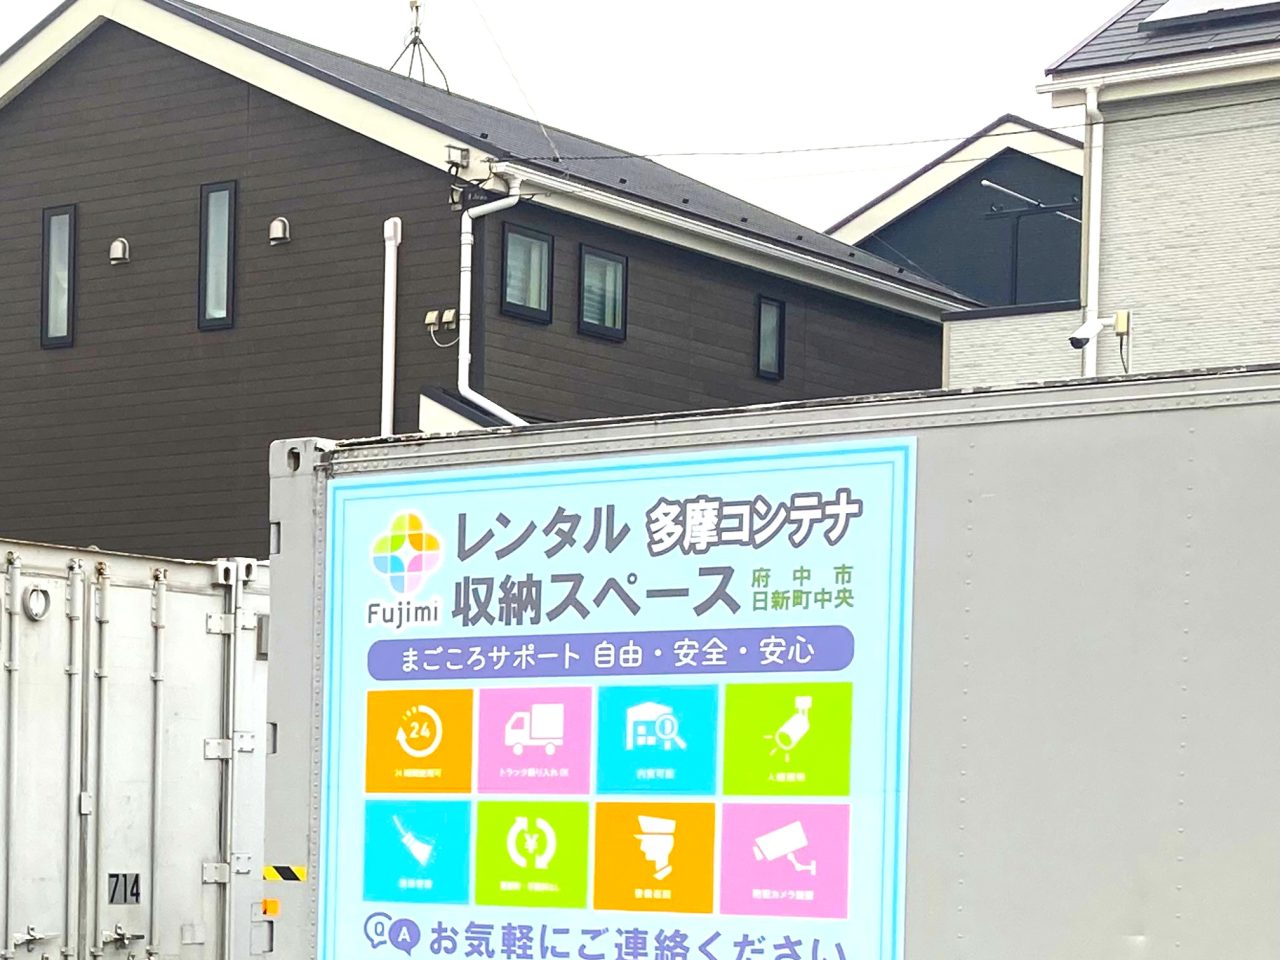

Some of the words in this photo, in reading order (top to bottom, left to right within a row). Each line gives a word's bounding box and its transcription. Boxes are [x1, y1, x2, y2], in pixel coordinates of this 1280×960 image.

[456, 503, 631, 562] レンタル
[645, 488, 863, 557] 多摩コンテナ
[451, 565, 742, 627] 収納スペース
[752, 587, 854, 612] 日新町中央
[367, 599, 439, 630] Fujimi
[401, 640, 581, 673] まごころサポート
[593, 635, 816, 670] 自由・安全・安心
[409, 721, 431, 739] 24
[108, 873, 140, 904] 714
